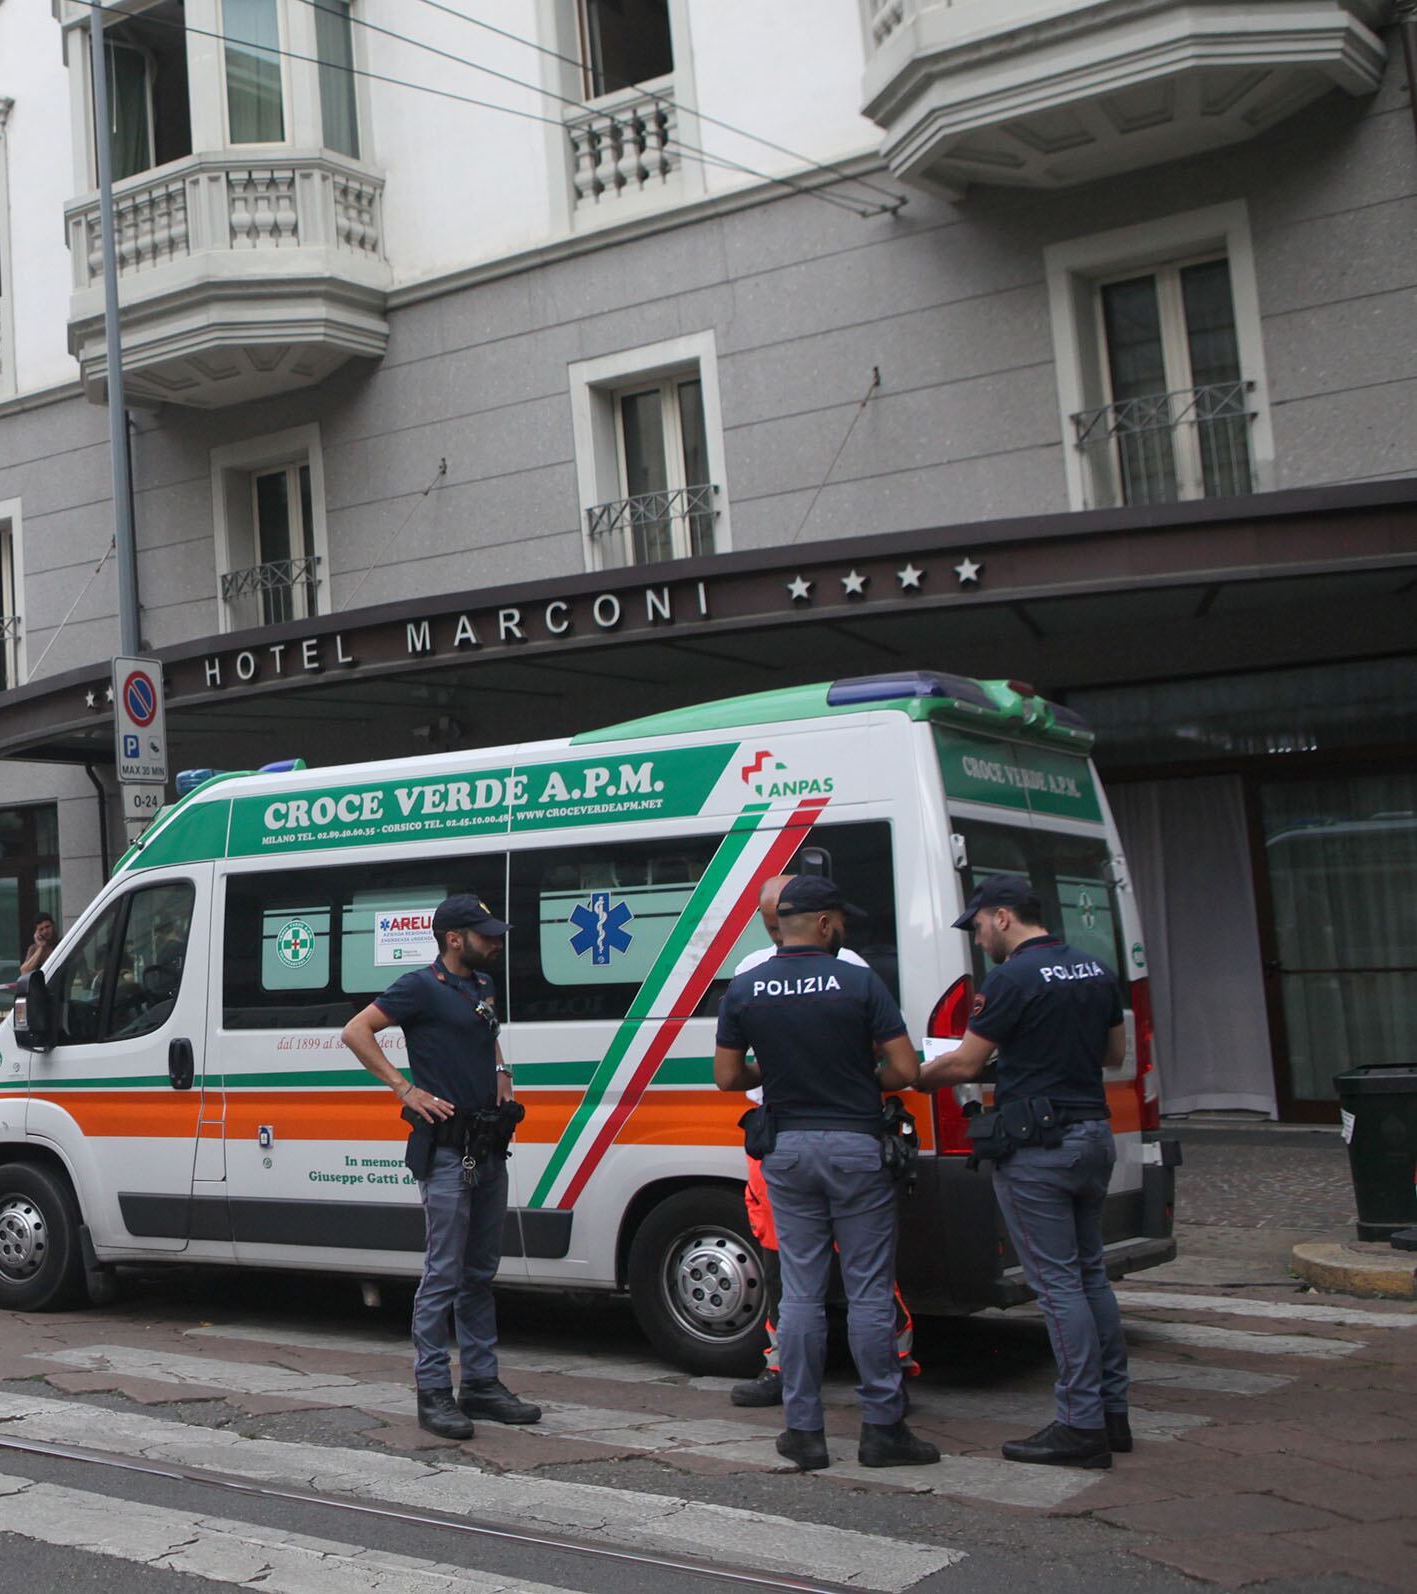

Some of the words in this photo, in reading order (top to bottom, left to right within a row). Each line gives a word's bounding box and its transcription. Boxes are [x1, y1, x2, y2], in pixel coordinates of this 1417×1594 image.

[205, 634, 353, 688] HOTEL
[406, 581, 708, 653] MARCONI
[122, 765, 141, 776] MAX
[152, 767, 165, 777] MIN
[962, 755, 1005, 784] CROCE
[1004, 765, 1048, 791] VERDE
[263, 790, 384, 830] CROCE
[394, 774, 529, 817] VERDE
[538, 761, 665, 803] A.P.M.
[768, 777, 834, 798] ANPAS
[134, 794, 158, 808] 0-24
[261, 834, 295, 845] MILANO
[297, 832, 316, 842] TEL.
[381, 821, 422, 834] CORSICO
[423, 819, 444, 830] TEL.
[389, 916, 431, 931] AREU
[1040, 961, 1105, 983] POLIZIA
[753, 975, 841, 997] POLIZIA
[276, 1036, 293, 1050] dal
[296, 1037, 321, 1050] 1899
[322, 1035, 334, 1049] al
[345, 1155, 358, 1167] In
[361, 1157, 408, 1168] memor
[309, 1170, 364, 1185] Giuseppe
[367, 1172, 399, 1185] Gatti
[403, 1174, 417, 1185] de
